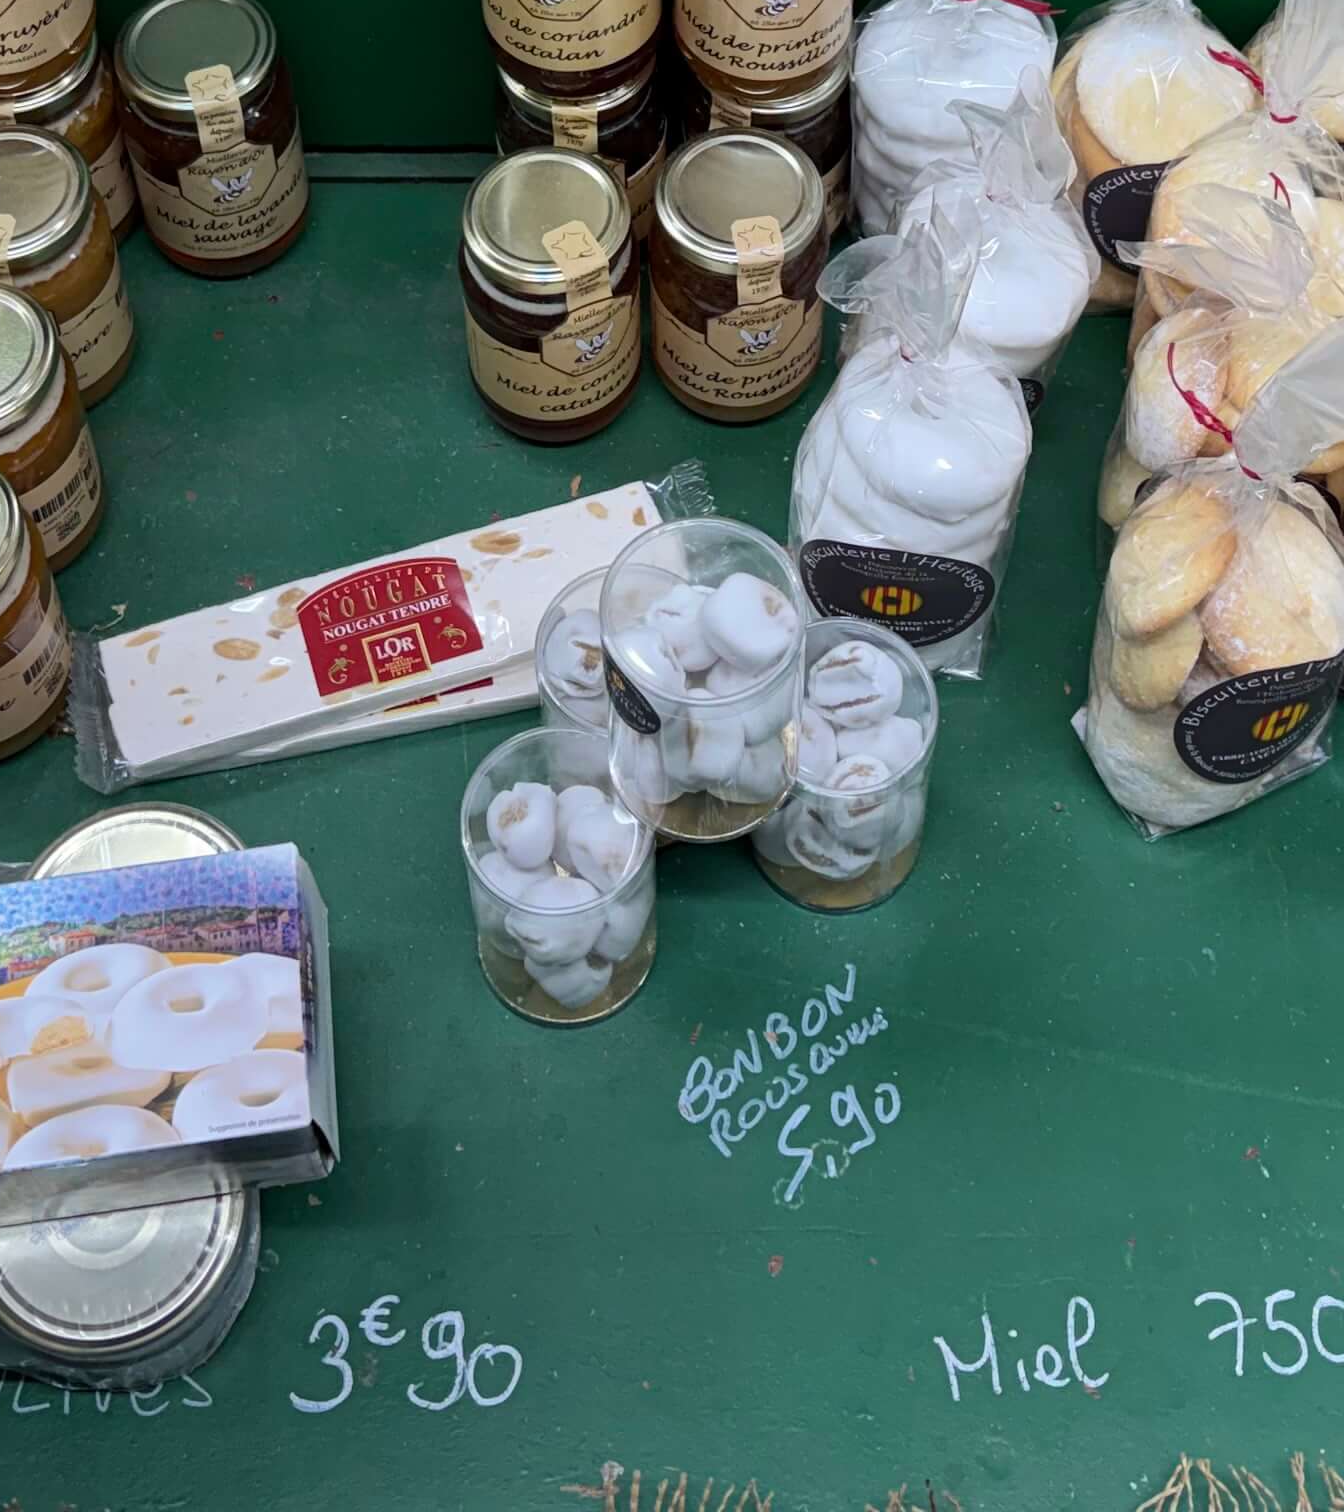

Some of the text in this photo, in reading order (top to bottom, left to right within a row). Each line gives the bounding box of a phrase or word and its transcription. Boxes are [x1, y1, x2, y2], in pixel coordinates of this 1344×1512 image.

[504, 33, 605, 61] catalan
[540, 2, 649, 42] coriandre
[694, 33, 845, 71] du Roussillon
[239, 170, 304, 227] lavande
[193, 214, 279, 244] sauvage
[317, 573, 447, 627] NOUGAT
[322, 592, 452, 642] NOUGAT TENDRE
[678, 962, 858, 1125] BONBON
[933, 1294, 1110, 1403] Miel
